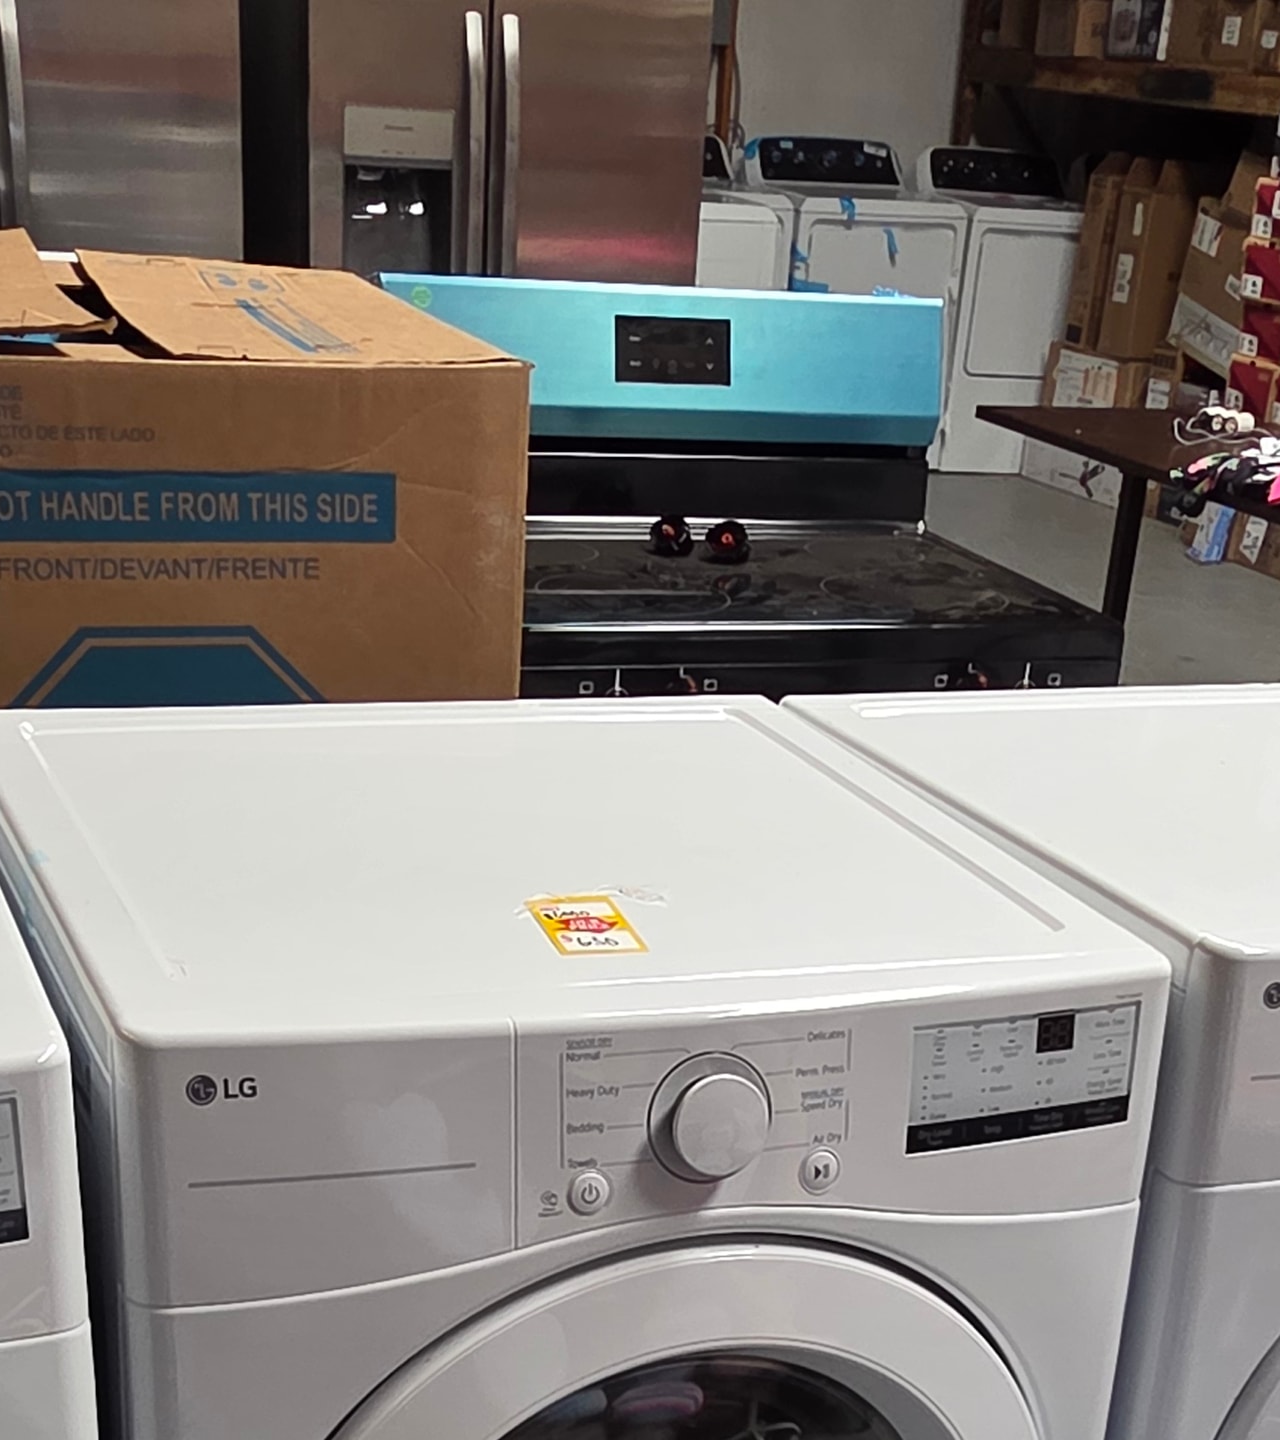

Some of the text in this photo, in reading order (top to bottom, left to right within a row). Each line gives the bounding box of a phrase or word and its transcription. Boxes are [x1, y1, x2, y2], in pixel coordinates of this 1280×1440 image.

[37, 423, 58, 440] DE
[111, 427, 155, 443] LADO
[40, 490, 150, 522] HANDLE
[160, 492, 239, 522] FROM
[247, 493, 308, 523] THIS
[317, 493, 379, 523] SIDE
[223, 1077, 258, 1100] LG
[566, 1085, 620, 1099] Heavy Duty
[566, 1123, 604, 1134] Bedding
